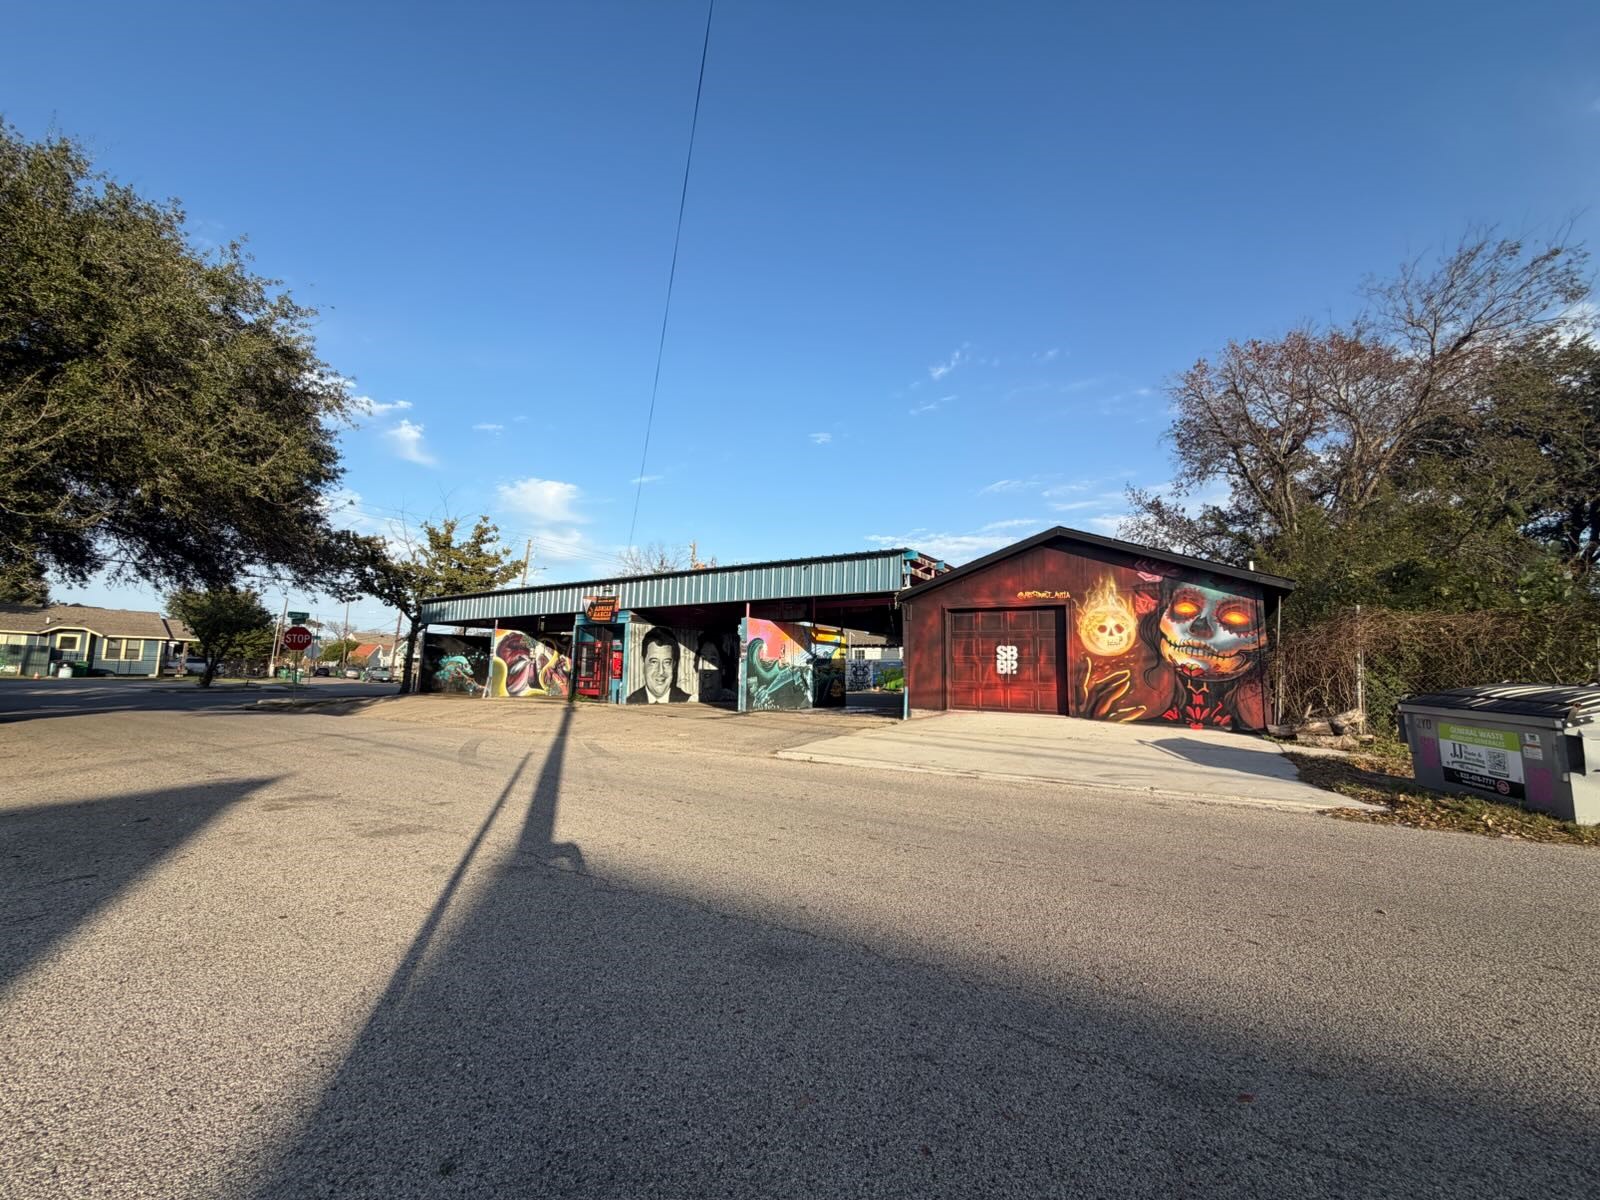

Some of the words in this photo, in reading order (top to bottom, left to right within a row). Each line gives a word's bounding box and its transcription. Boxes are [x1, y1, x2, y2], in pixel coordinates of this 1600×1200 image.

[286, 634, 310, 643] STOP
[996, 645, 1018, 660] SB
[1449, 726, 1478, 737] GENERAL
[1479, 730, 1504, 741] WASTE
